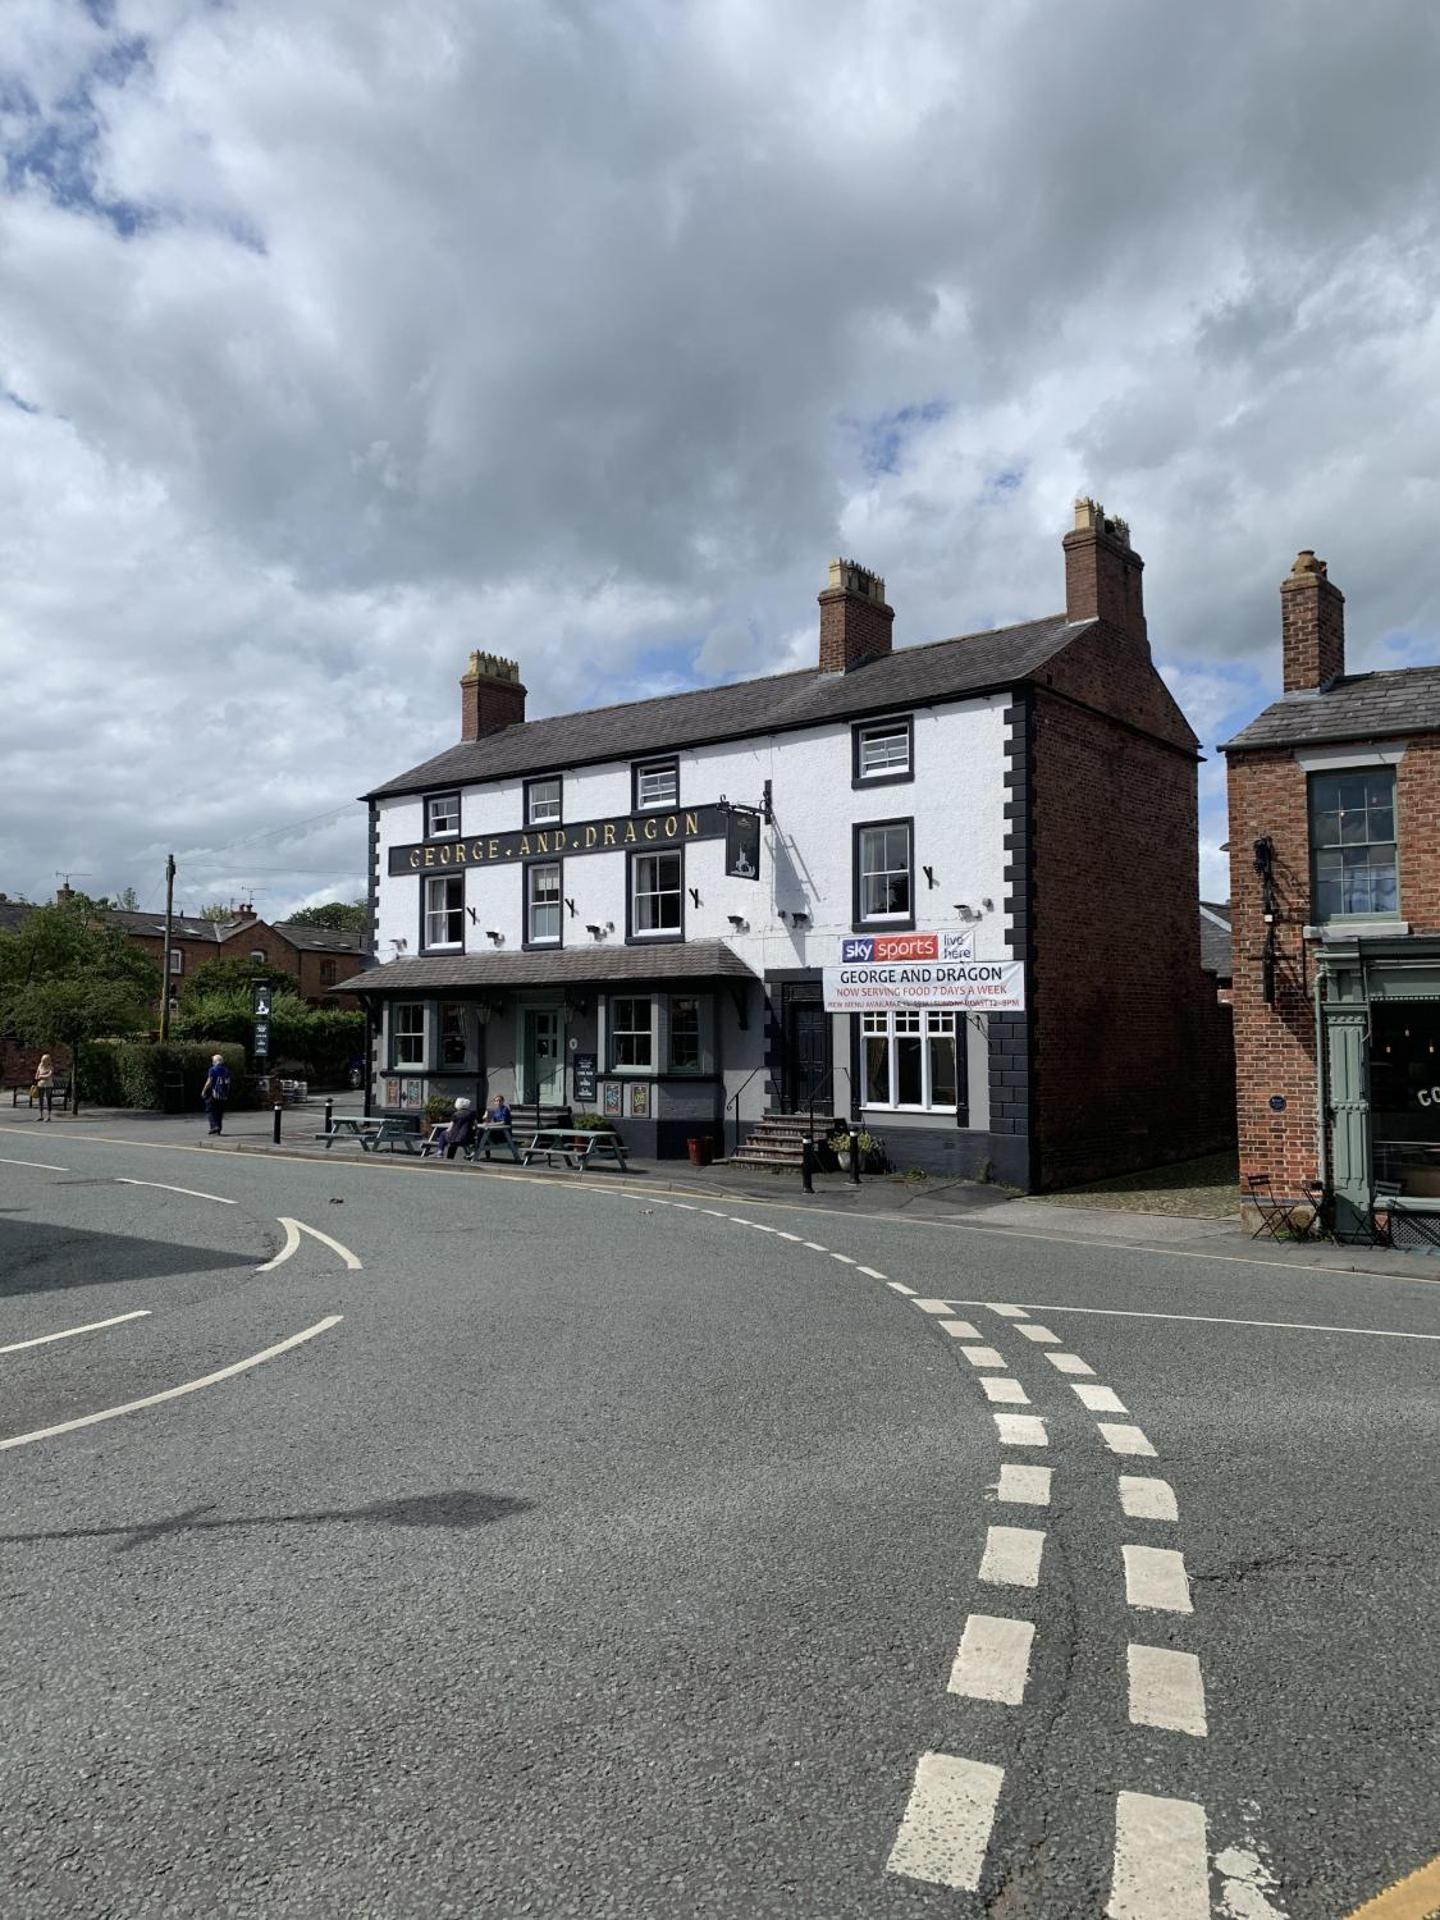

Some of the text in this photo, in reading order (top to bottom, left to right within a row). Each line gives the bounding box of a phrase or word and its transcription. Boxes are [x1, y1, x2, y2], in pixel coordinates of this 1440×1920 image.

[409, 812, 699, 867] GEORGE AND DRAGON
[943, 934, 964, 946] live
[846, 939, 934, 960] sky sports
[943, 948, 971, 959] here
[840, 967, 1002, 984] GEORGE AND DRAGON
[836, 985, 1007, 997] NOW SERVING FOOD 7 DAYS A WEEK
